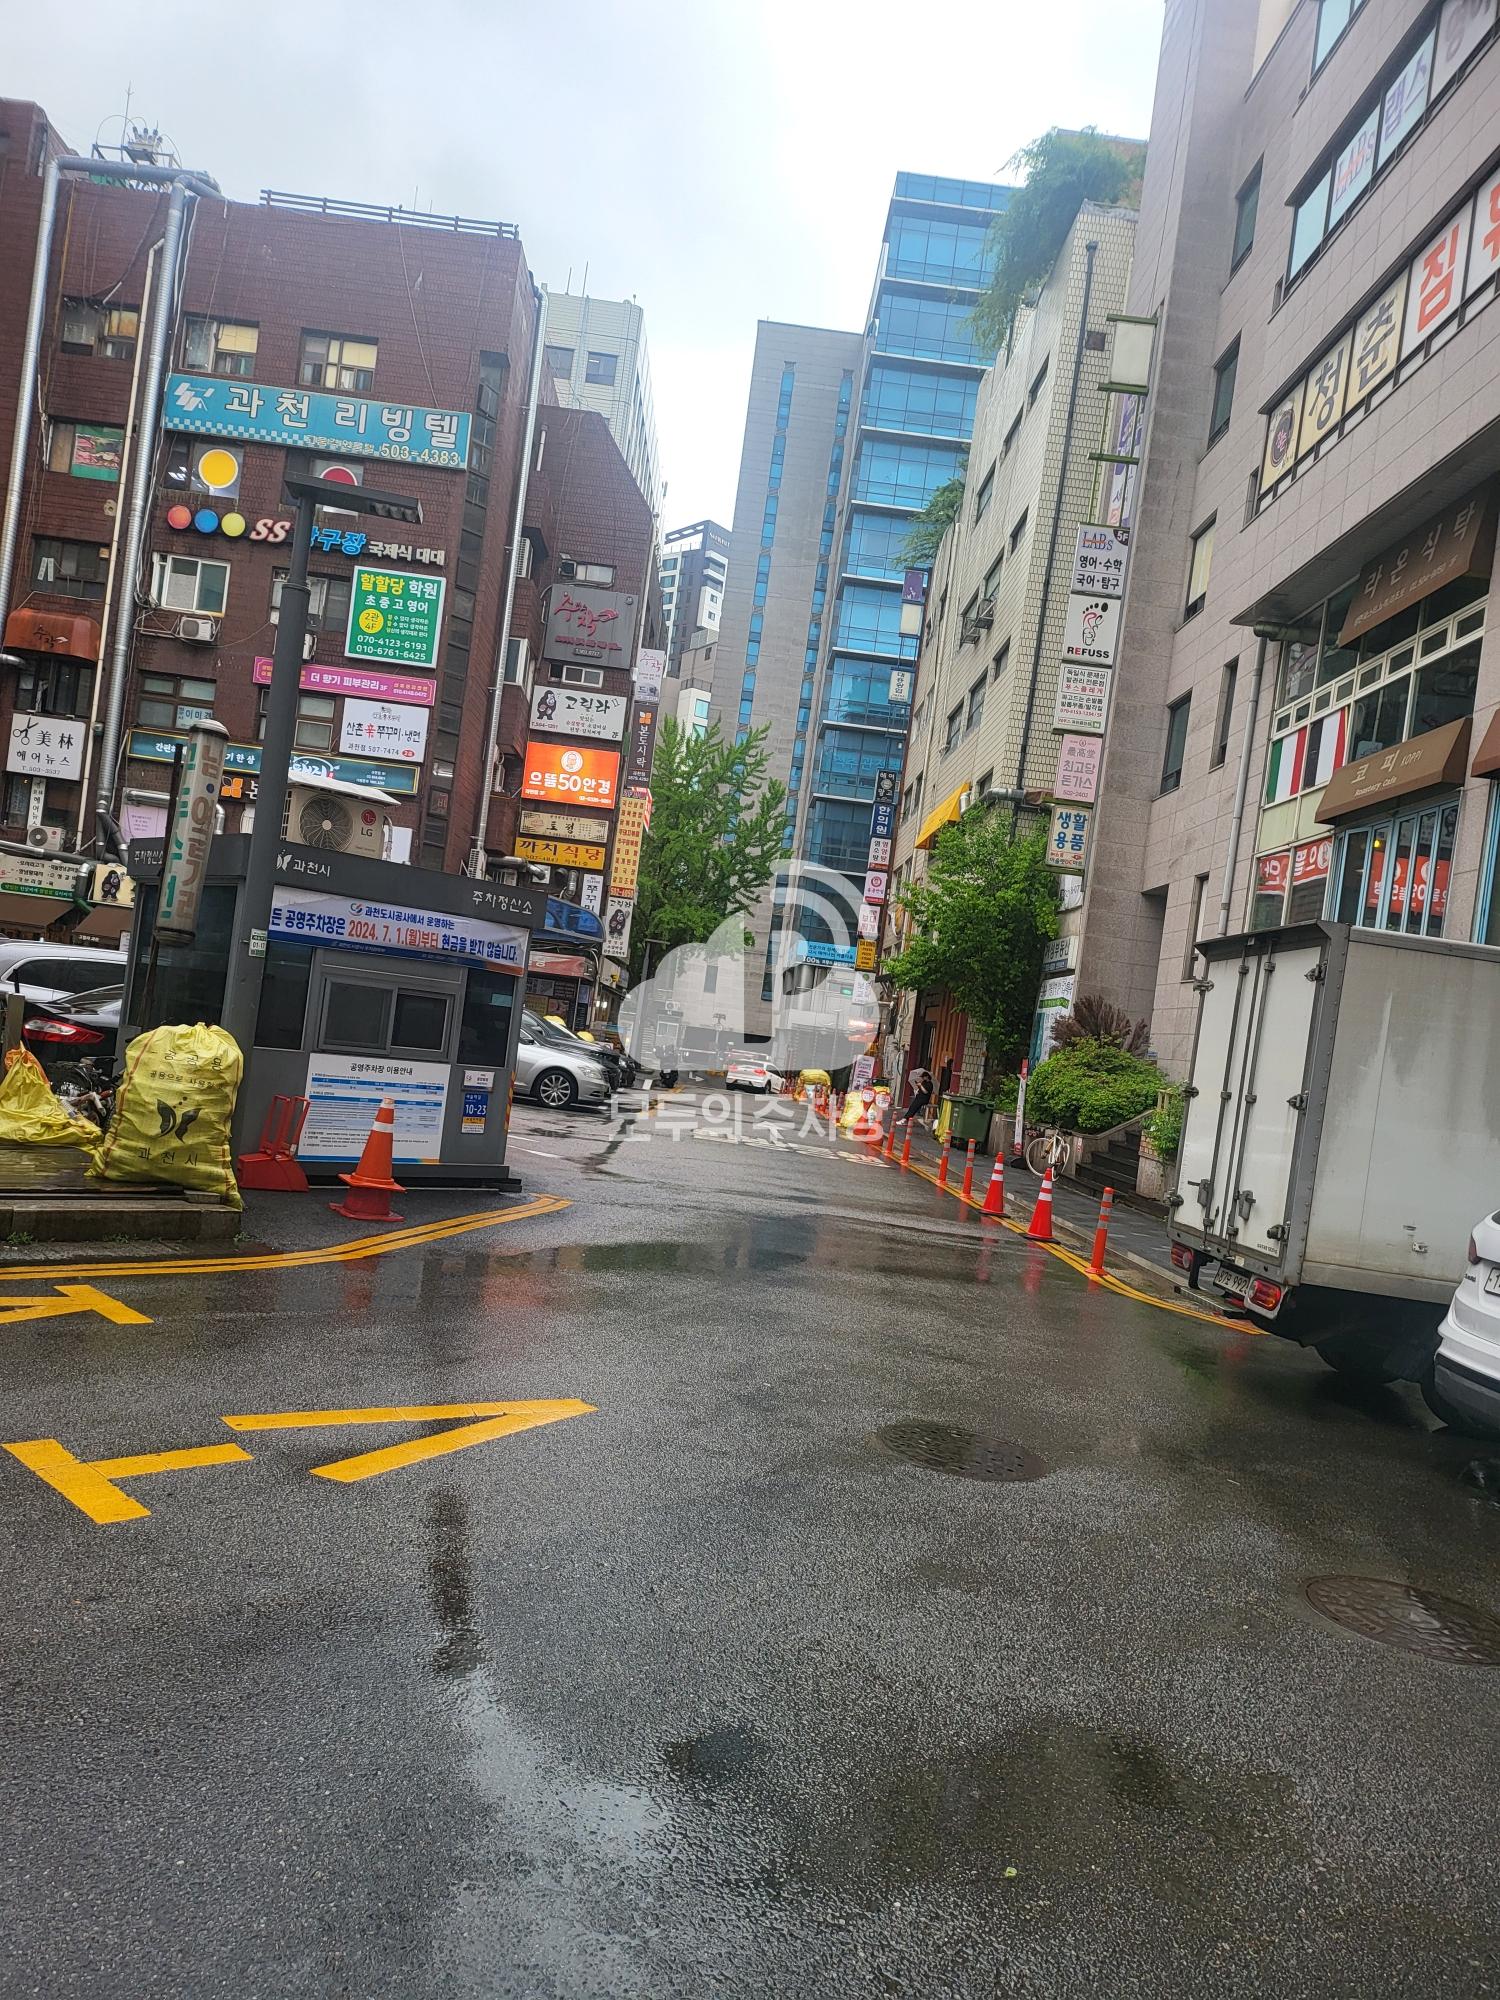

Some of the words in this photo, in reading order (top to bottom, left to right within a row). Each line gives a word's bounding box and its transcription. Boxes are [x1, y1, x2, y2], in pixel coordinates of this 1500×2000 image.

[1309, 295, 1397, 430] 청춘
[225, 386, 311, 428] 과천
[334, 402, 460, 449] 리빙텔
[379, 443, 460, 465] 503-4383
[251, 518, 291, 543] SS
[369, 541, 412, 561] 국제식
[416, 548, 445, 566] 대대
[1116, 531, 1129, 542] 5F
[409, 580, 437, 600] 학원
[407, 600, 429, 614] 영어
[356, 645, 426, 660] 010-6761-6425
[357, 635, 427, 650] 070-4123-6193
[1067, 646, 1110, 659] REFUSS
[311, 673, 320, 683] 더
[322, 674, 341, 686] 향기
[343, 676, 380, 691] 피부관리
[565, 695, 610, 714] 고릴라
[36, 730, 74, 750] 美林
[637, 725, 650, 768] 본도시락
[16, 750, 70, 767] 헤어뉴스
[1063, 760, 1096, 775] 최고당
[529, 771, 611, 795] 으뜸50안경
[1061, 775, 1092, 789] 돈가스
[876, 806, 890, 835] 한의원
[1057, 811, 1088, 832] 생활
[361, 827, 373, 837] LG
[1054, 831, 1085, 852] 용품
[519, 840, 603, 861] 까치식당
[293, 859, 331, 877] 과천시
[471, 890, 534, 915] 주차정산소
[365, 906, 424, 925] 과천도시공사에서
[427, 916, 455, 930] 운영하는
[284, 909, 346, 937] 공영주차장은
[348, 919, 378, 941] 2024.
[383, 924, 392, 943] 7.
[442, 933, 466, 952] 현금을
[469, 938, 485, 954] 받지
[486, 942, 519, 961] 않습니다.
[350, 1063, 385, 1074] 공영주차장
[386, 1065, 413, 1076] 이용안내
[465, 1104, 487, 1115] 10-23
[138, 1147, 198, 1167] 과천시
